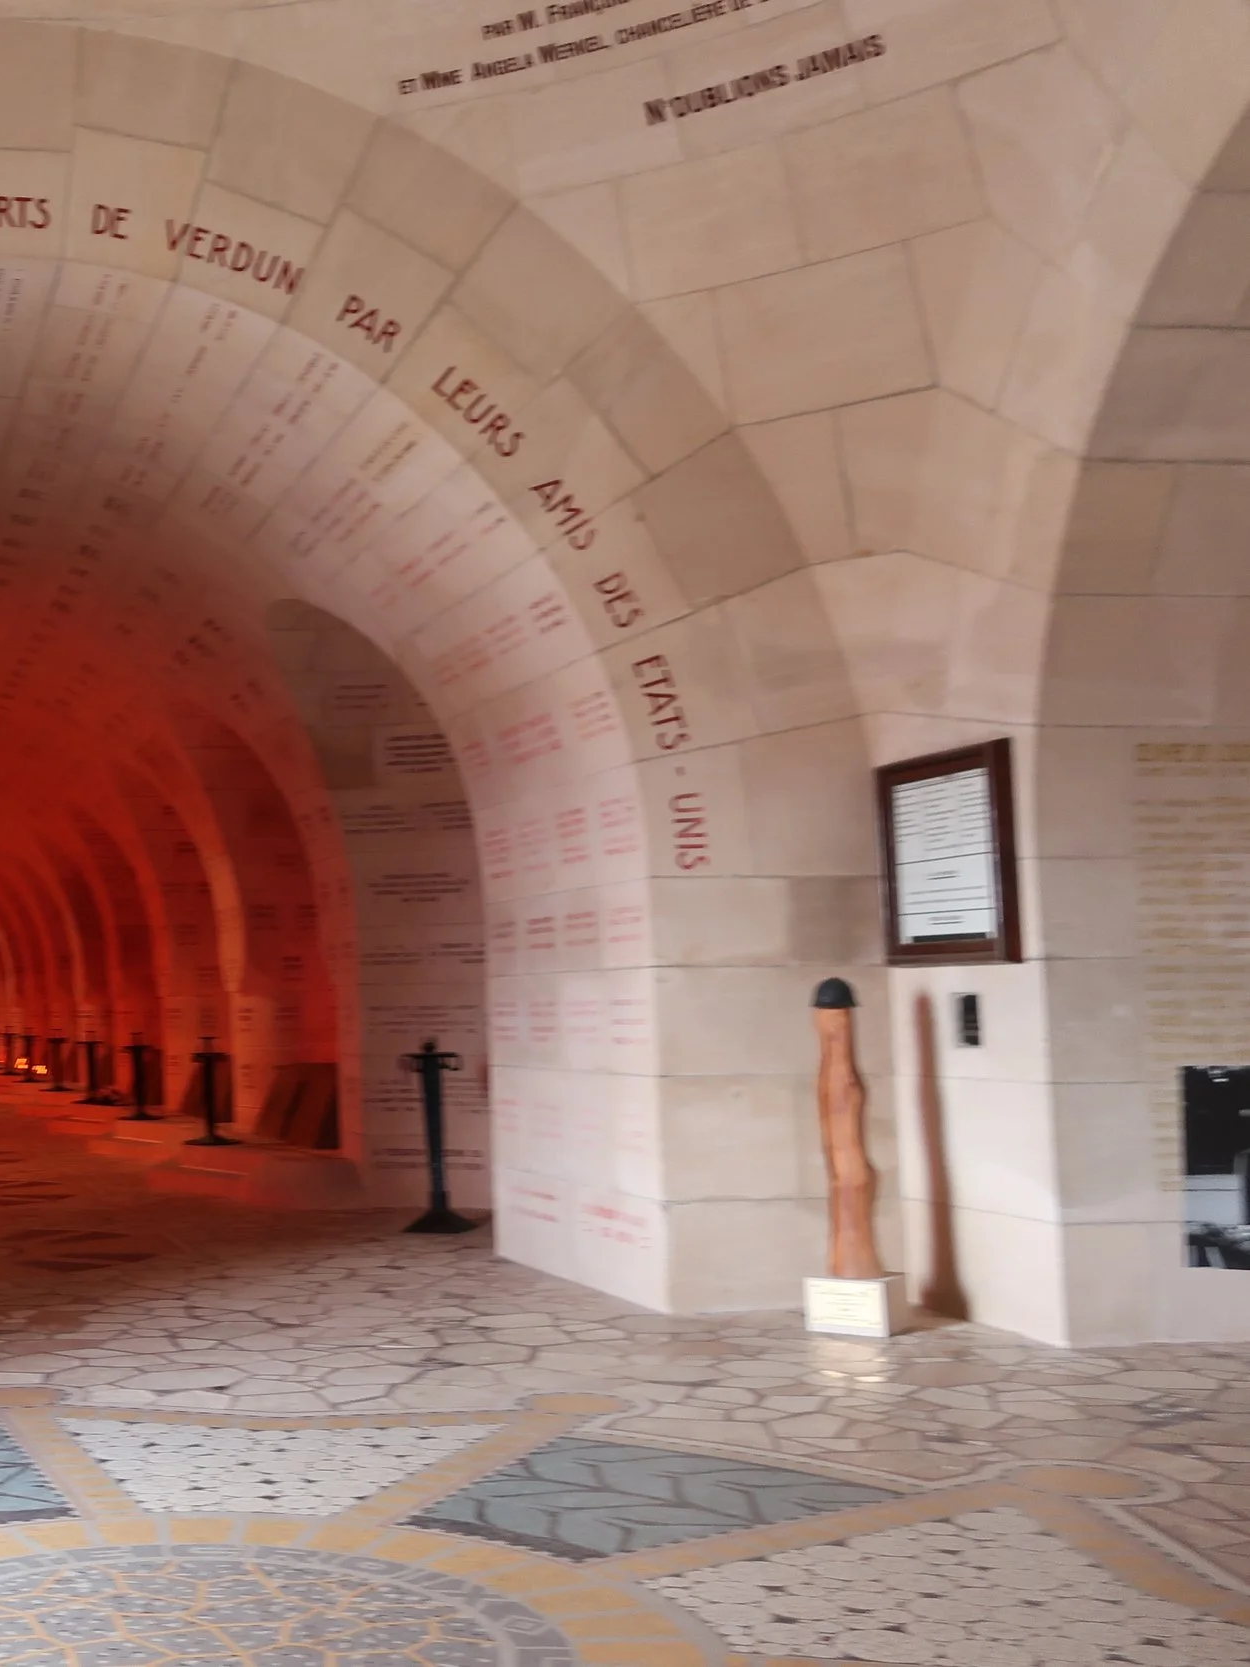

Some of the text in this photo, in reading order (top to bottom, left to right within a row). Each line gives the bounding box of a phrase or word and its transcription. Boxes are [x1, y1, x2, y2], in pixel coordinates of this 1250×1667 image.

[471, 53, 534, 81] ANGELA
[794, 34, 887, 81] JAMAIS
[90, 204, 131, 240] DE
[166, 219, 306, 296] VERDUN
[336, 293, 401, 354] PAR
[431, 365, 527, 458] LEURS
[529, 479, 597, 551] AMIS
[595, 572, 647, 629] DES
[631, 654, 692, 750] ETATS
[668, 792, 711, 871] UNIS
